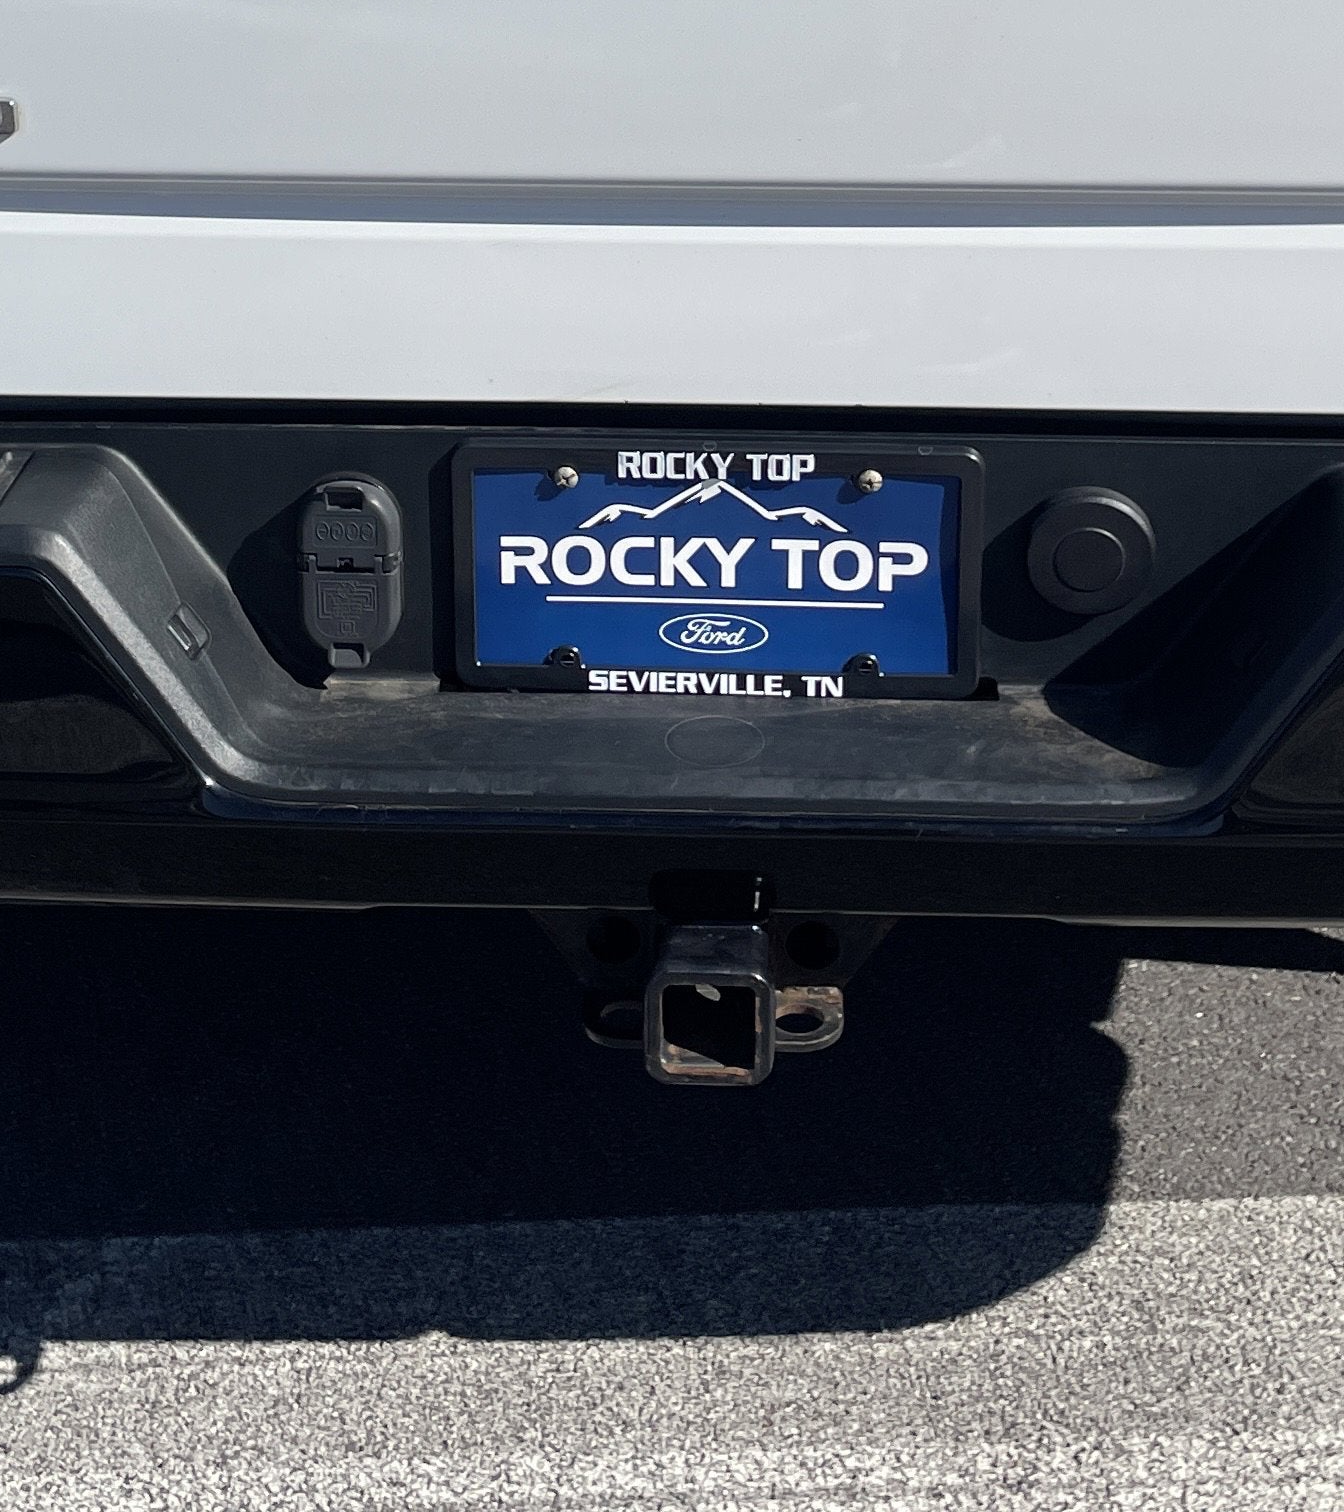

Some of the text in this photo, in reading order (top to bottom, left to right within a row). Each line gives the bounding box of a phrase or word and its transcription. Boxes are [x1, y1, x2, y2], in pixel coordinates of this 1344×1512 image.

[617, 451, 815, 482] ROCKY TOP
[500, 535, 929, 592] ROCKY TOP
[680, 619, 747, 647] Ford
[588, 669, 844, 698] SEVIERVILLE, TN
